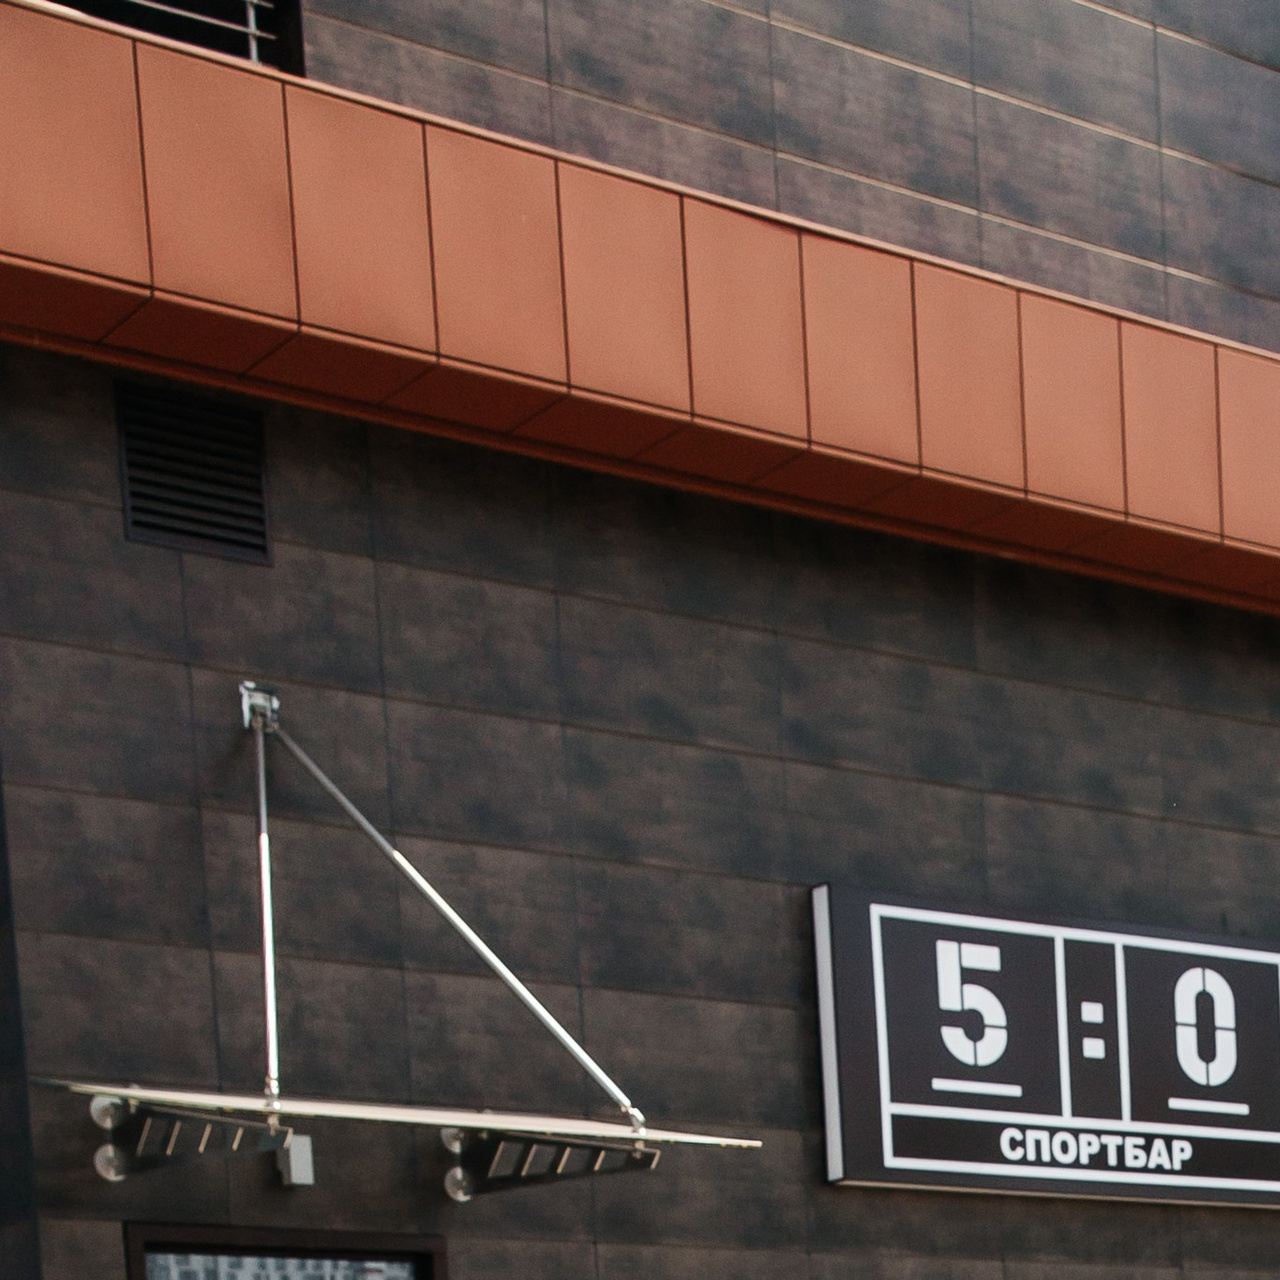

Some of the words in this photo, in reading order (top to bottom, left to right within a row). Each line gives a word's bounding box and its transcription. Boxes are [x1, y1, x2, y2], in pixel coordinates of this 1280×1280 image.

[936, 939, 1007, 1066] 5
[1174, 967, 1237, 1086] 0
[1000, 1127, 1193, 1170] СПОРТБАР
